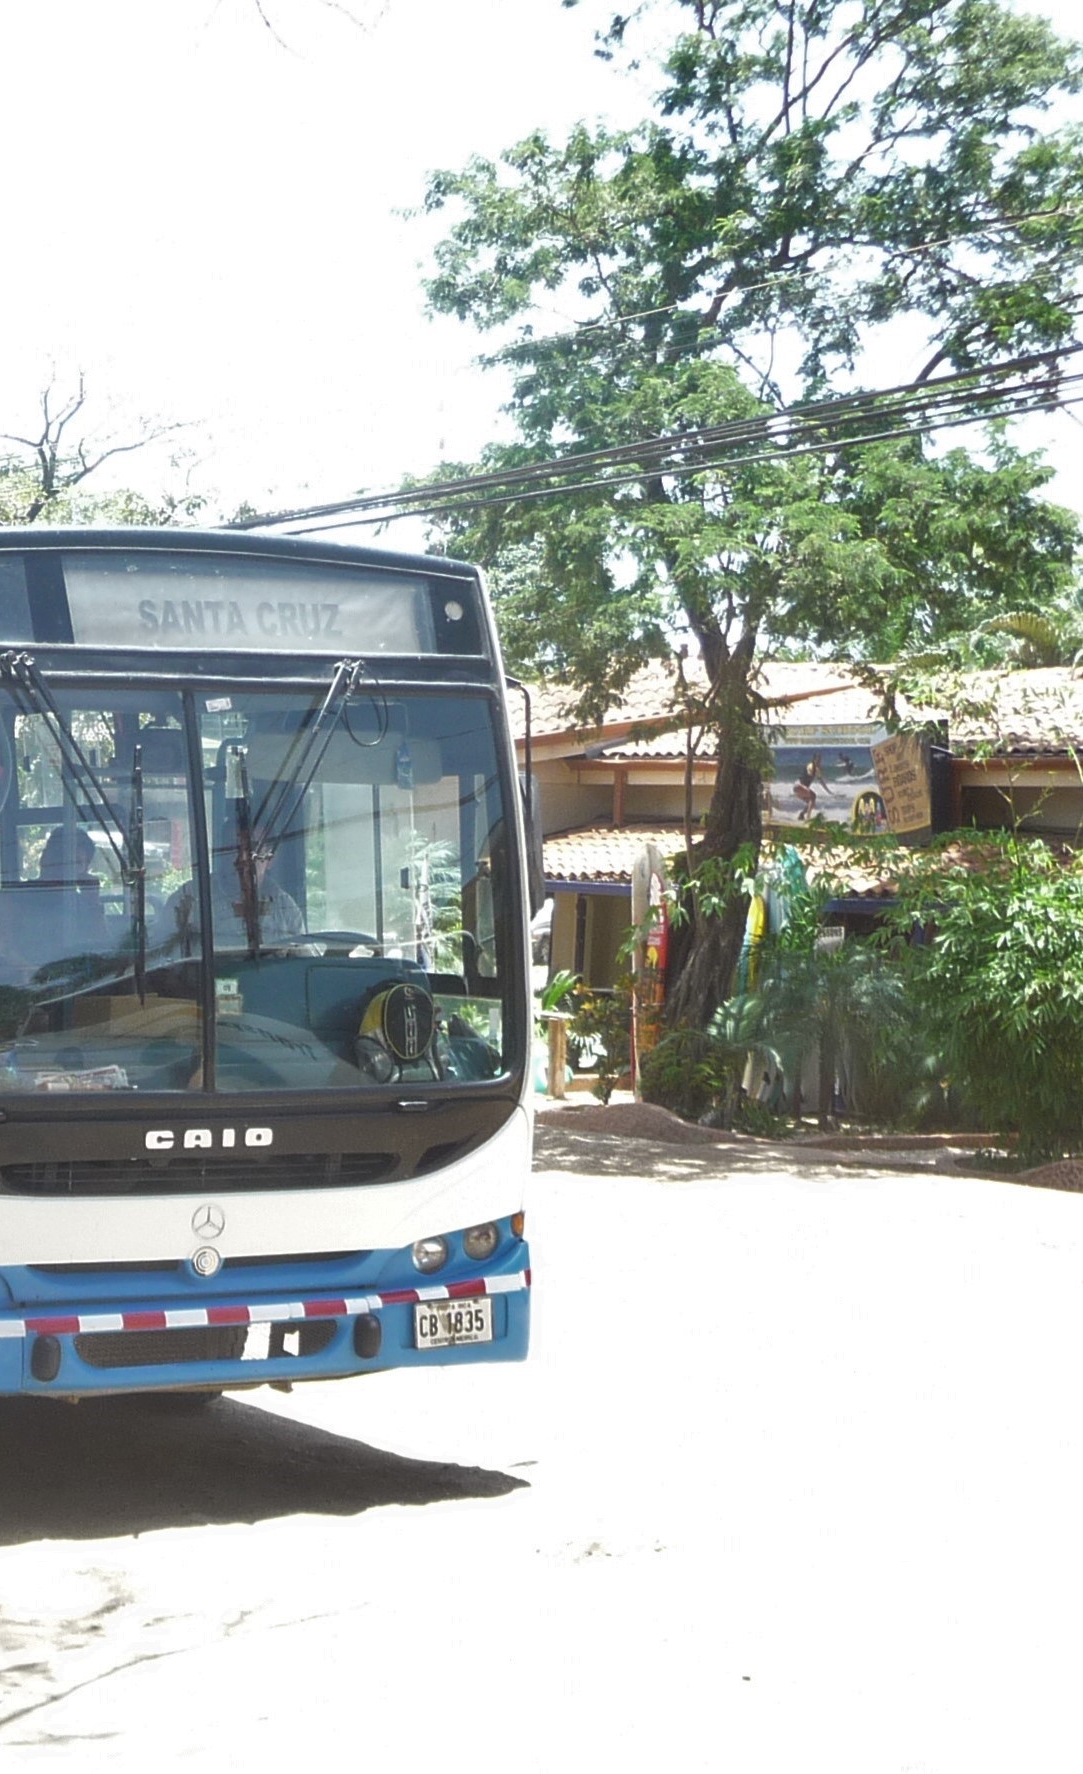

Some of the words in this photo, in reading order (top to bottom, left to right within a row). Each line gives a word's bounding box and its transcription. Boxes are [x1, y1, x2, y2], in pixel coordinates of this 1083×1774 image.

[138, 598, 247, 635] SANTA
[256, 601, 343, 638] CRUZ
[144, 1127, 274, 1150] CAIO
[419, 1313, 438, 1338] CB
[446, 1308, 485, 1335] 1835
